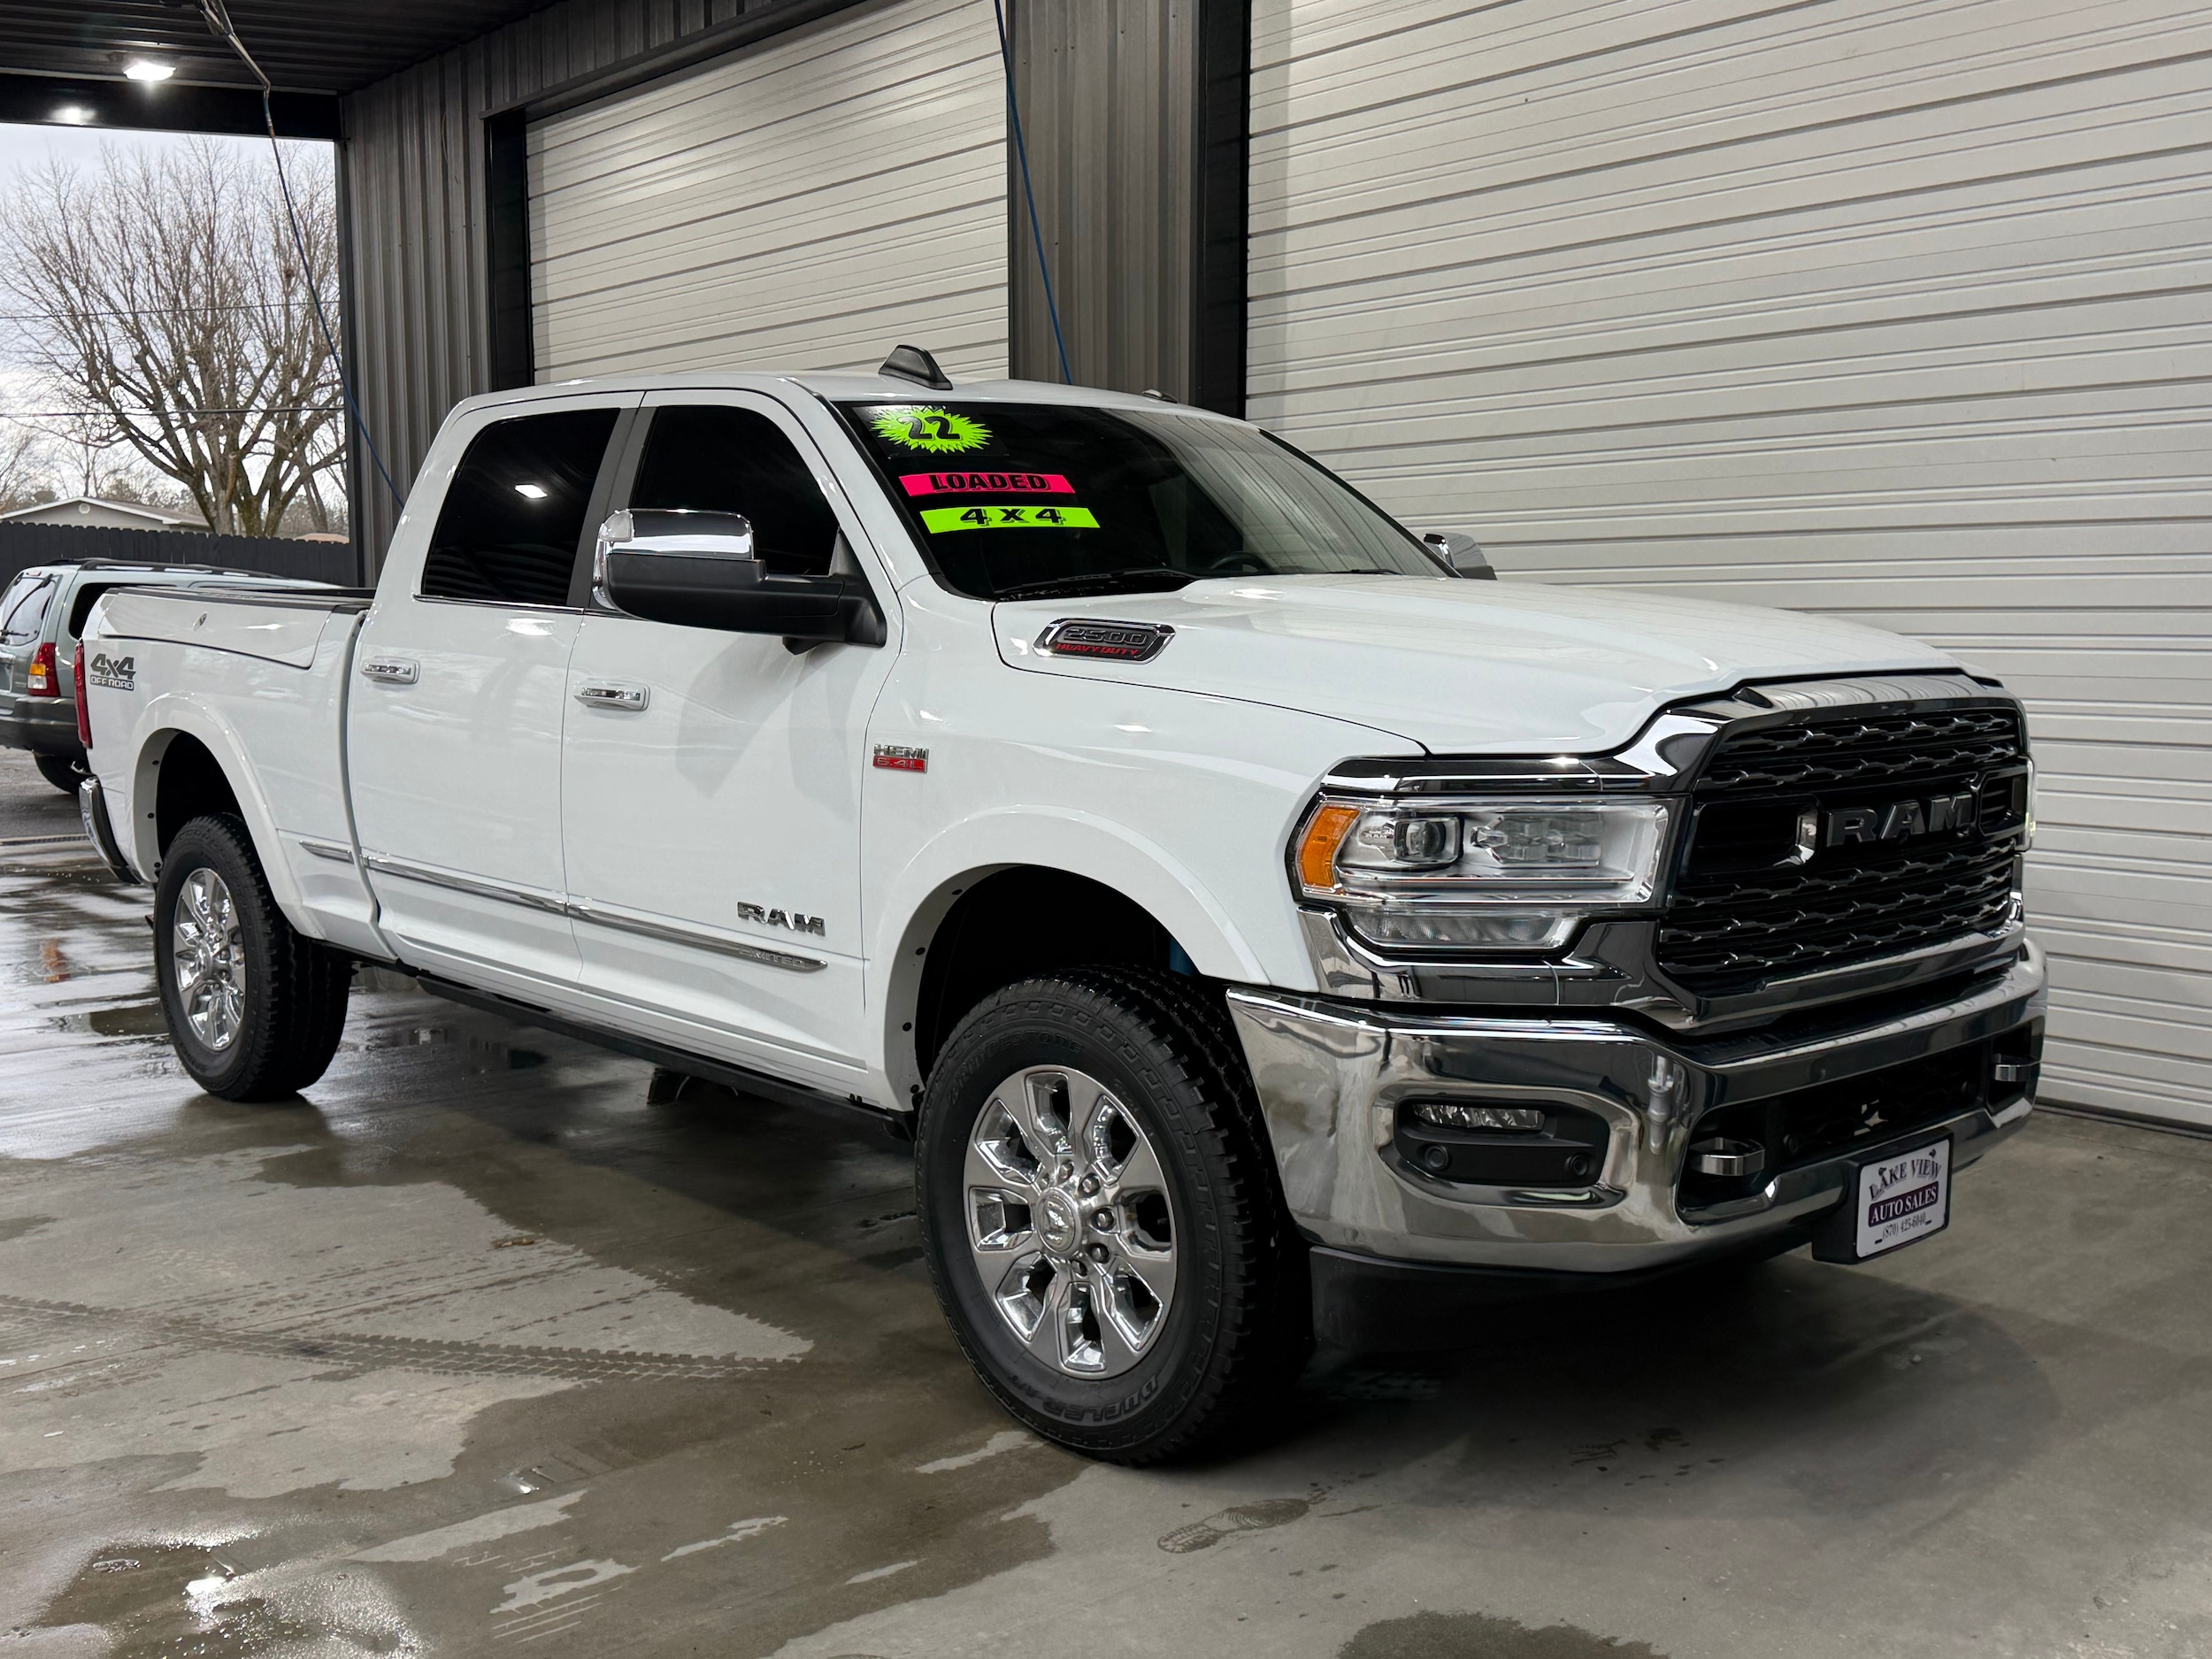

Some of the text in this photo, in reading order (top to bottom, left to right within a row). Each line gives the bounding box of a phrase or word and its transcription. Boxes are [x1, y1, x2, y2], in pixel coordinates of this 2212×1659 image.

[896, 415, 963, 441] 22
[929, 472, 1051, 492] LOADED
[1064, 628, 1148, 646] 2500
[1056, 643, 1141, 656] HEAVY DUTY
[90, 676, 134, 690] OFF ROAD
[874, 744, 929, 759] HEMI
[1826, 794, 1972, 847] RAM
[737, 902, 826, 937] RAM
[1869, 1159, 1942, 1201] LAKE VIEW
[1871, 1186, 1937, 1224] AUTO SALES
[1882, 1223, 1899, 1240] (870)
[1042, 1374, 1159, 1422] DUELER
